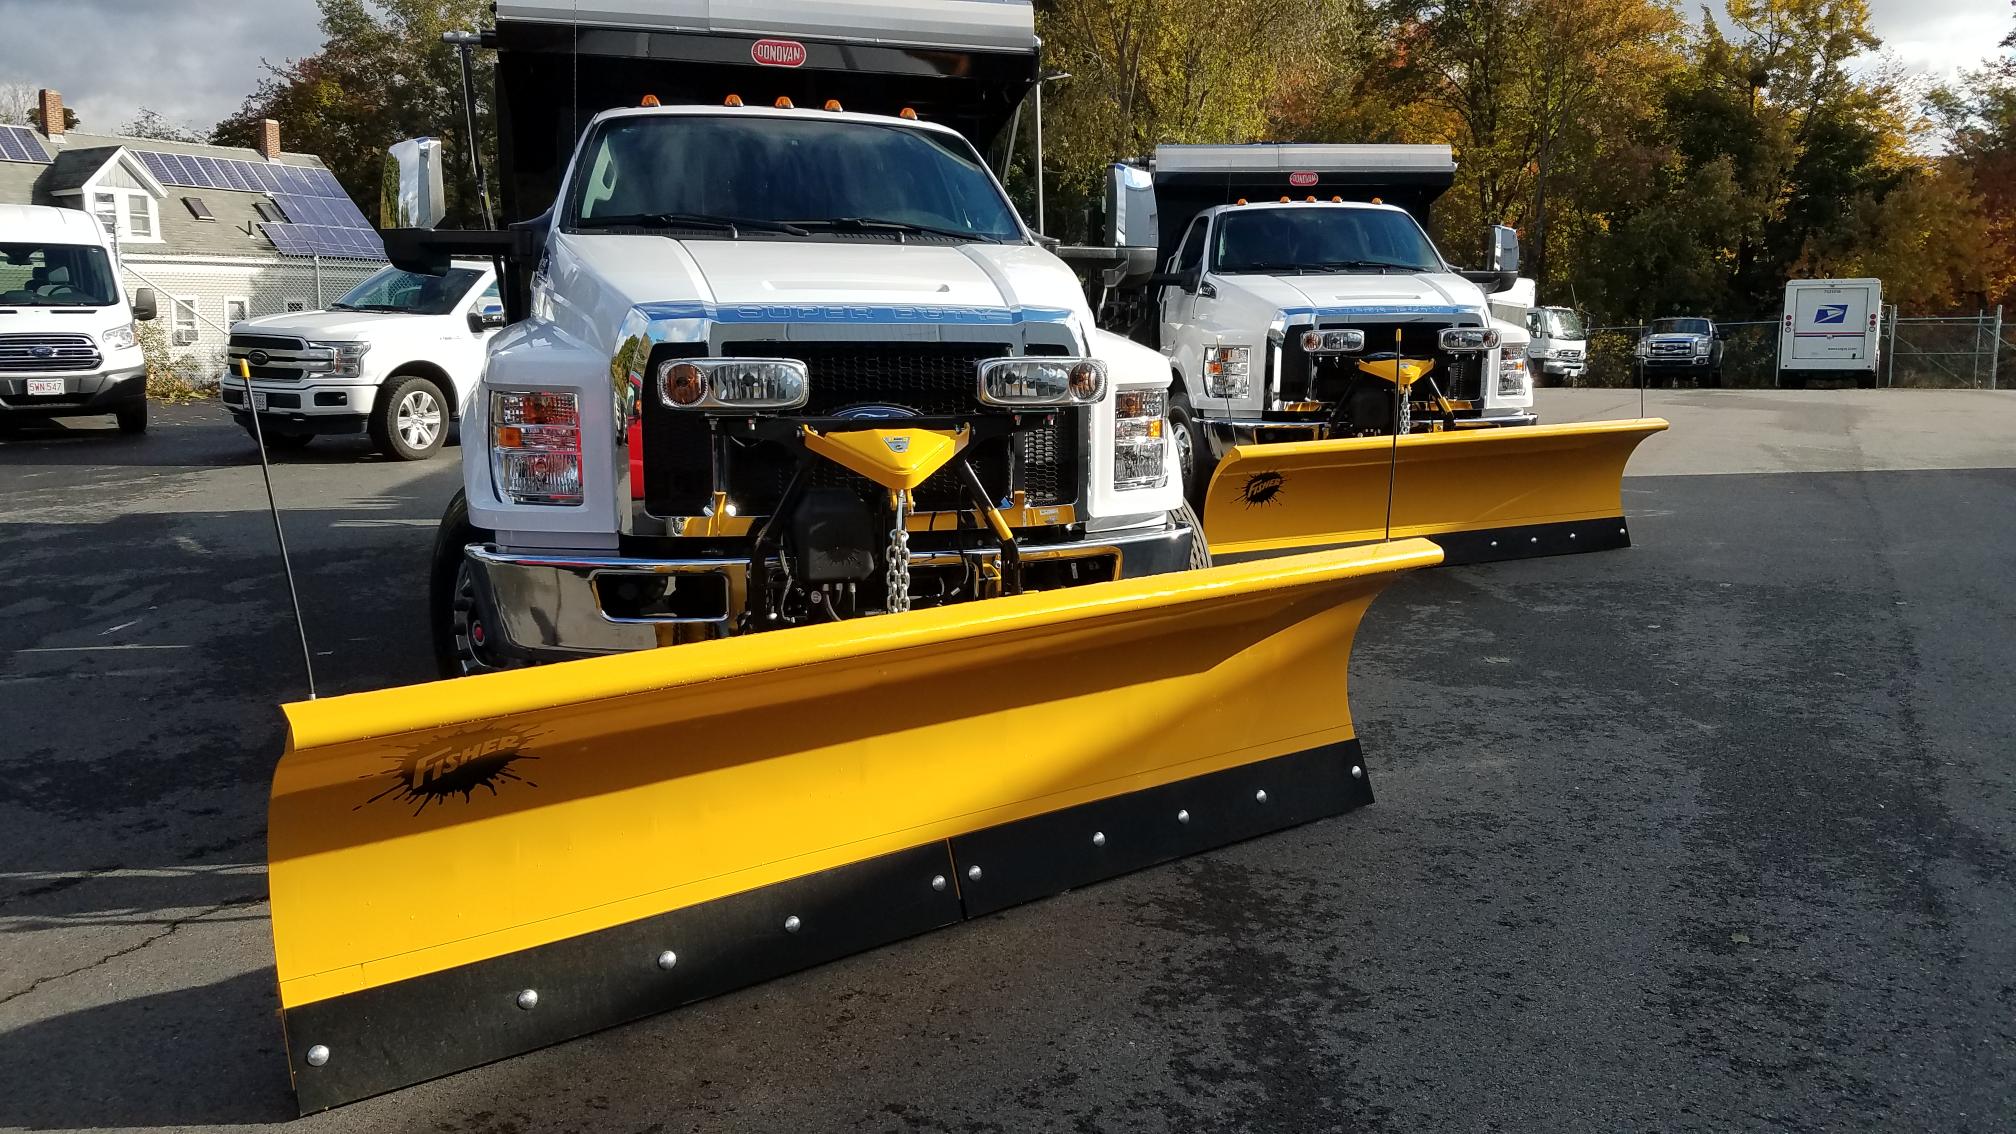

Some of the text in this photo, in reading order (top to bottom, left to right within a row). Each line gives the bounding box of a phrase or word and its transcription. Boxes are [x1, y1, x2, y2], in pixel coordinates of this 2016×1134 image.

[757, 44, 801, 62] DONOVAN
[737, 305, 994, 320] SUPER DUTY
[46, 382, 62, 392] 547
[412, 735, 520, 790] FISHER
